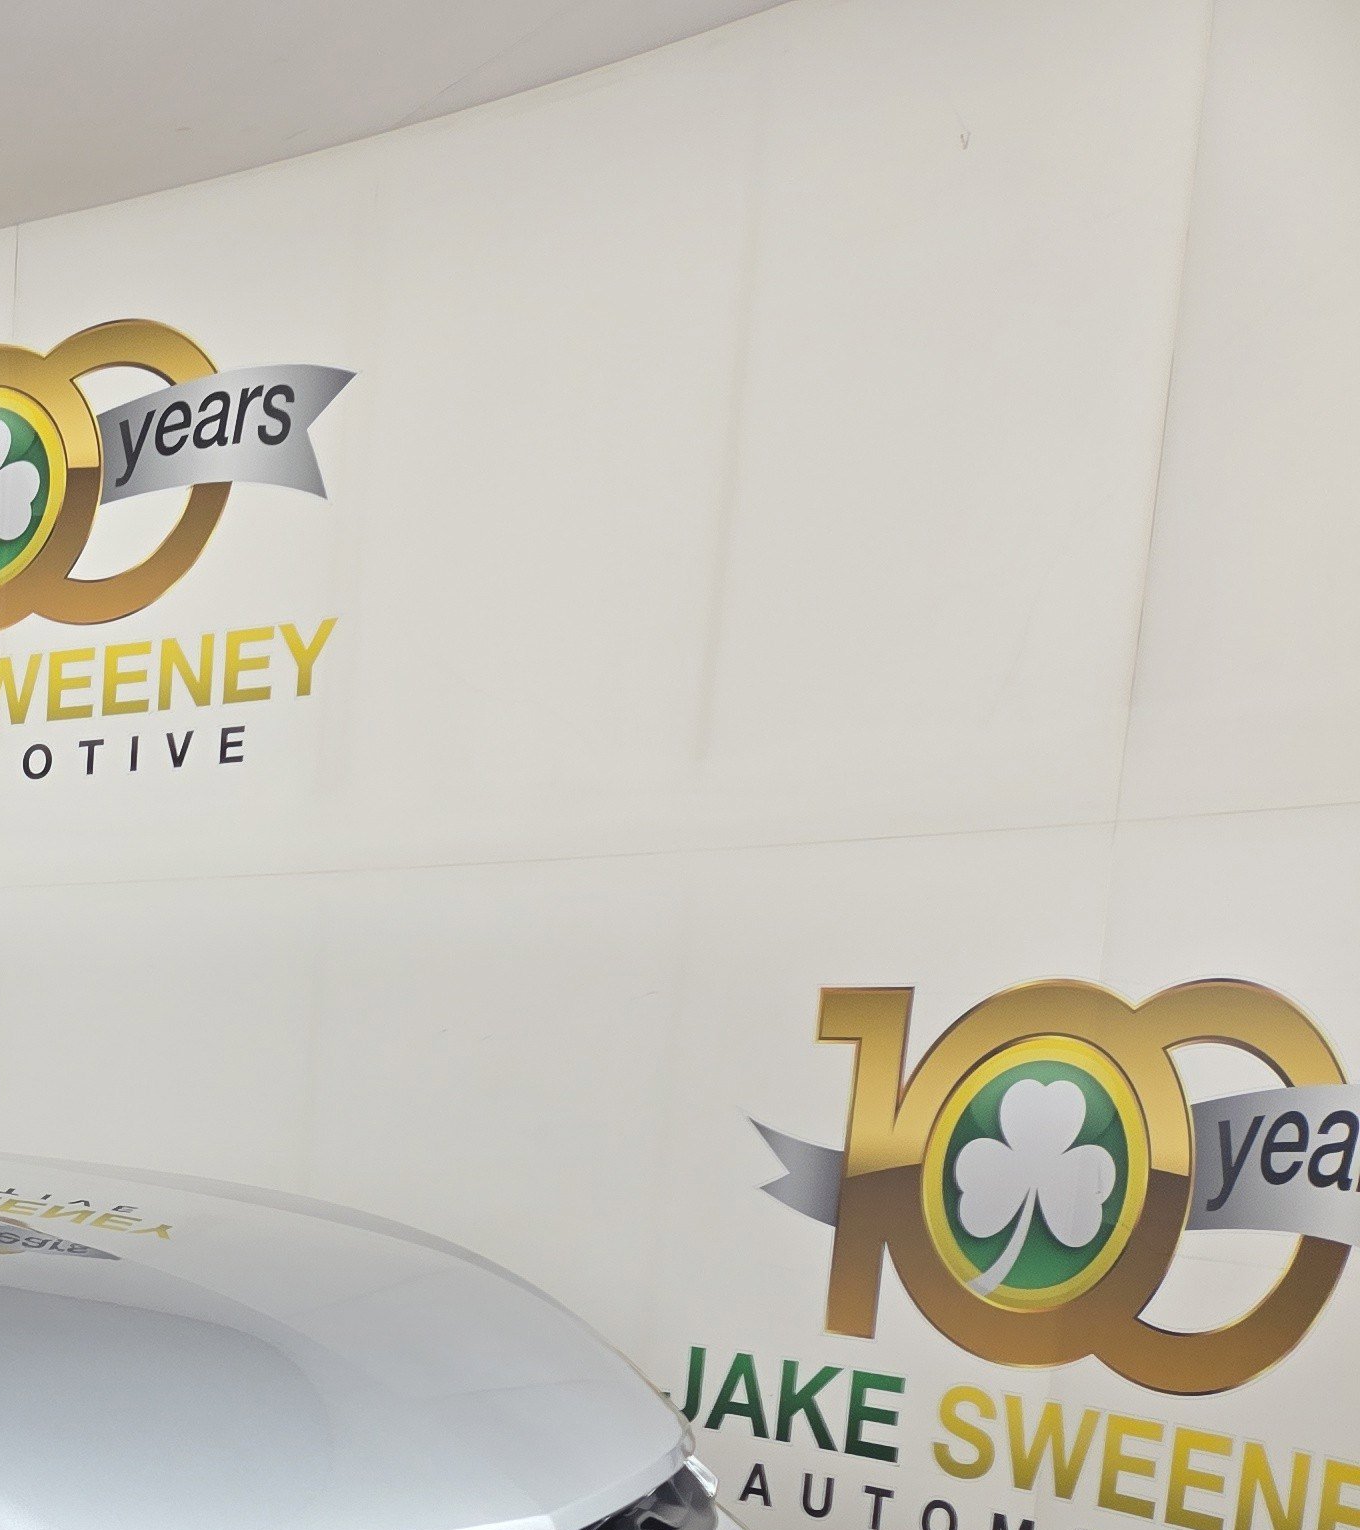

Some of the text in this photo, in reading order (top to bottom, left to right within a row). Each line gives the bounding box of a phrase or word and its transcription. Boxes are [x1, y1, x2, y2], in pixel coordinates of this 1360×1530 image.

[114, 383, 295, 488] years
[1206, 1110, 1360, 1211] yea
[660, 1346, 906, 1463] JAKE
